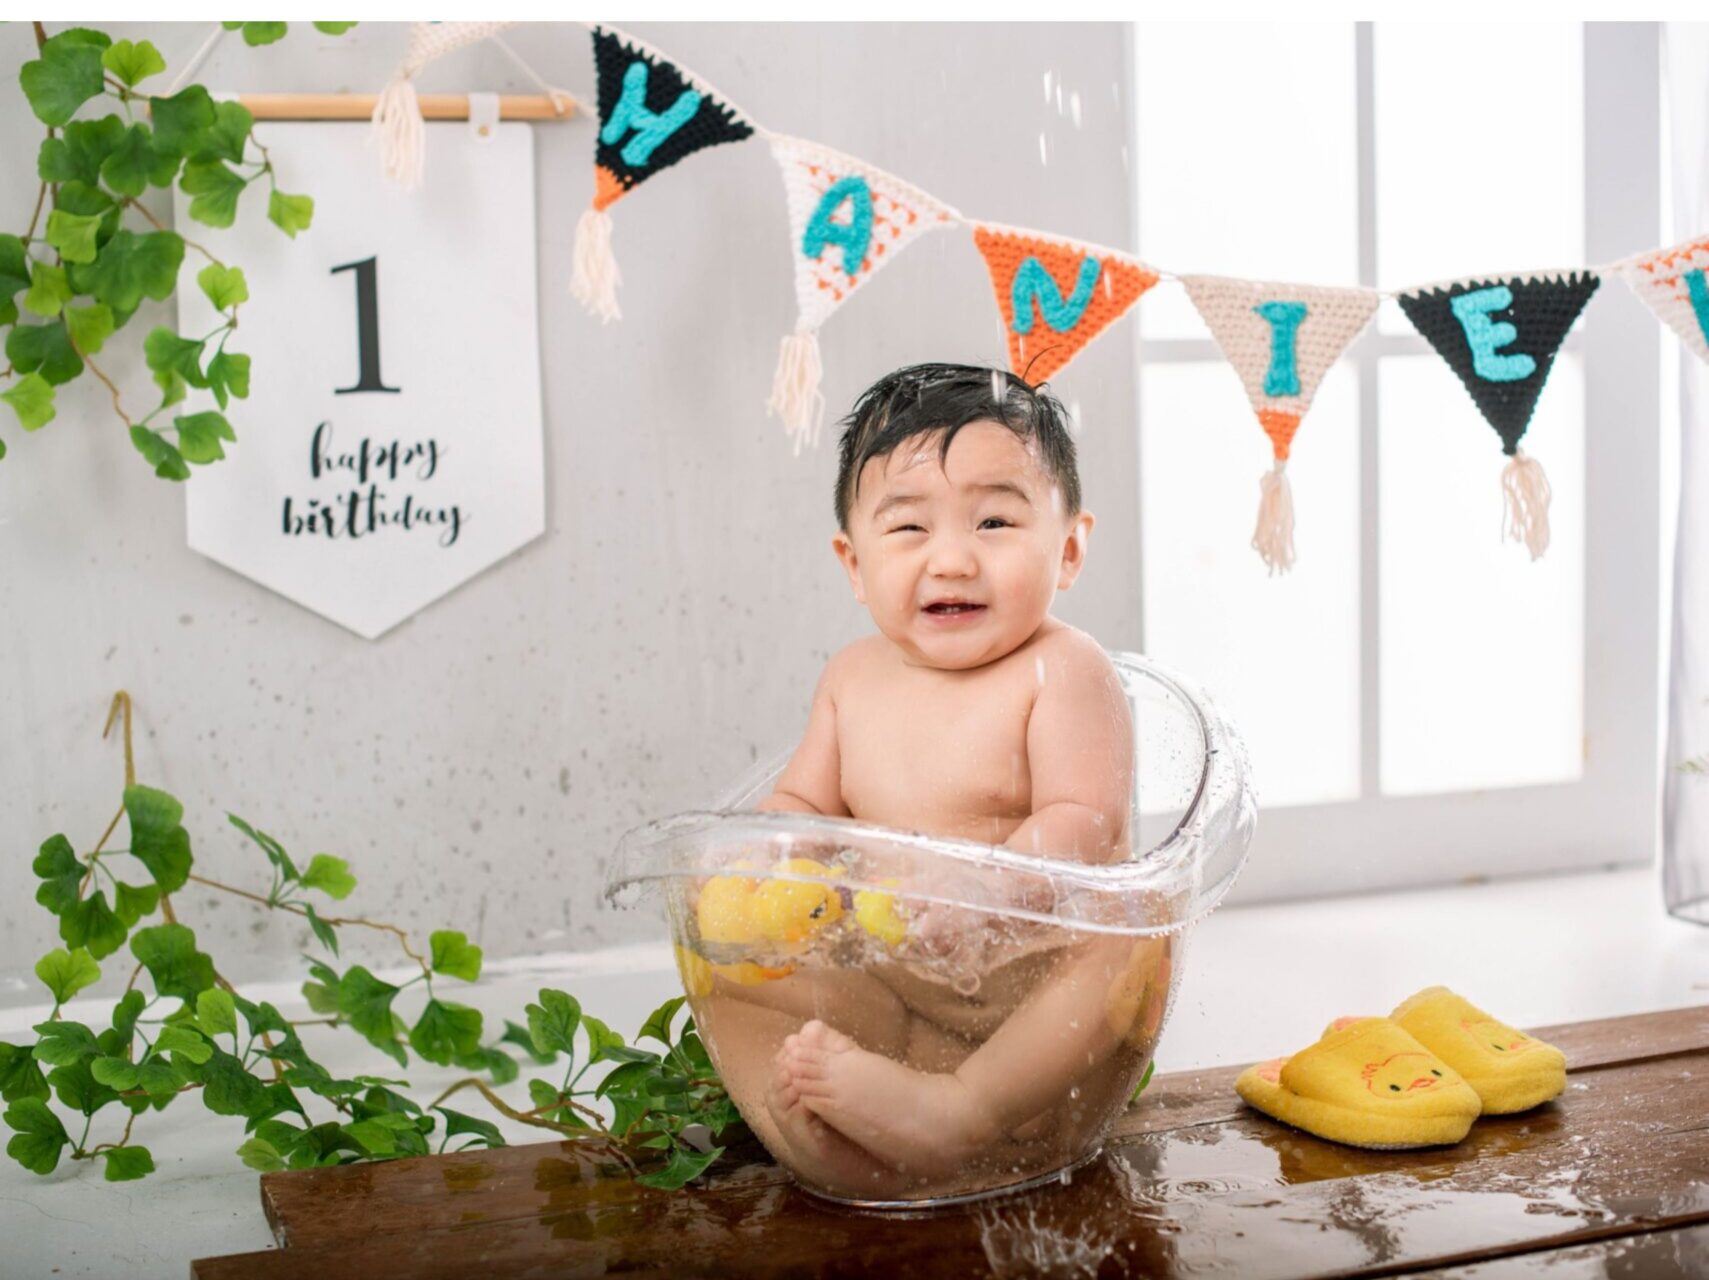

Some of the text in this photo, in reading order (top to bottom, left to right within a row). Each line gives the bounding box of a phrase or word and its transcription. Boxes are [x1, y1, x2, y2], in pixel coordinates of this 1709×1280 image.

[329, 255, 403, 396] 1
[310, 420, 447, 485] happy
[282, 483, 470, 548] birthday
